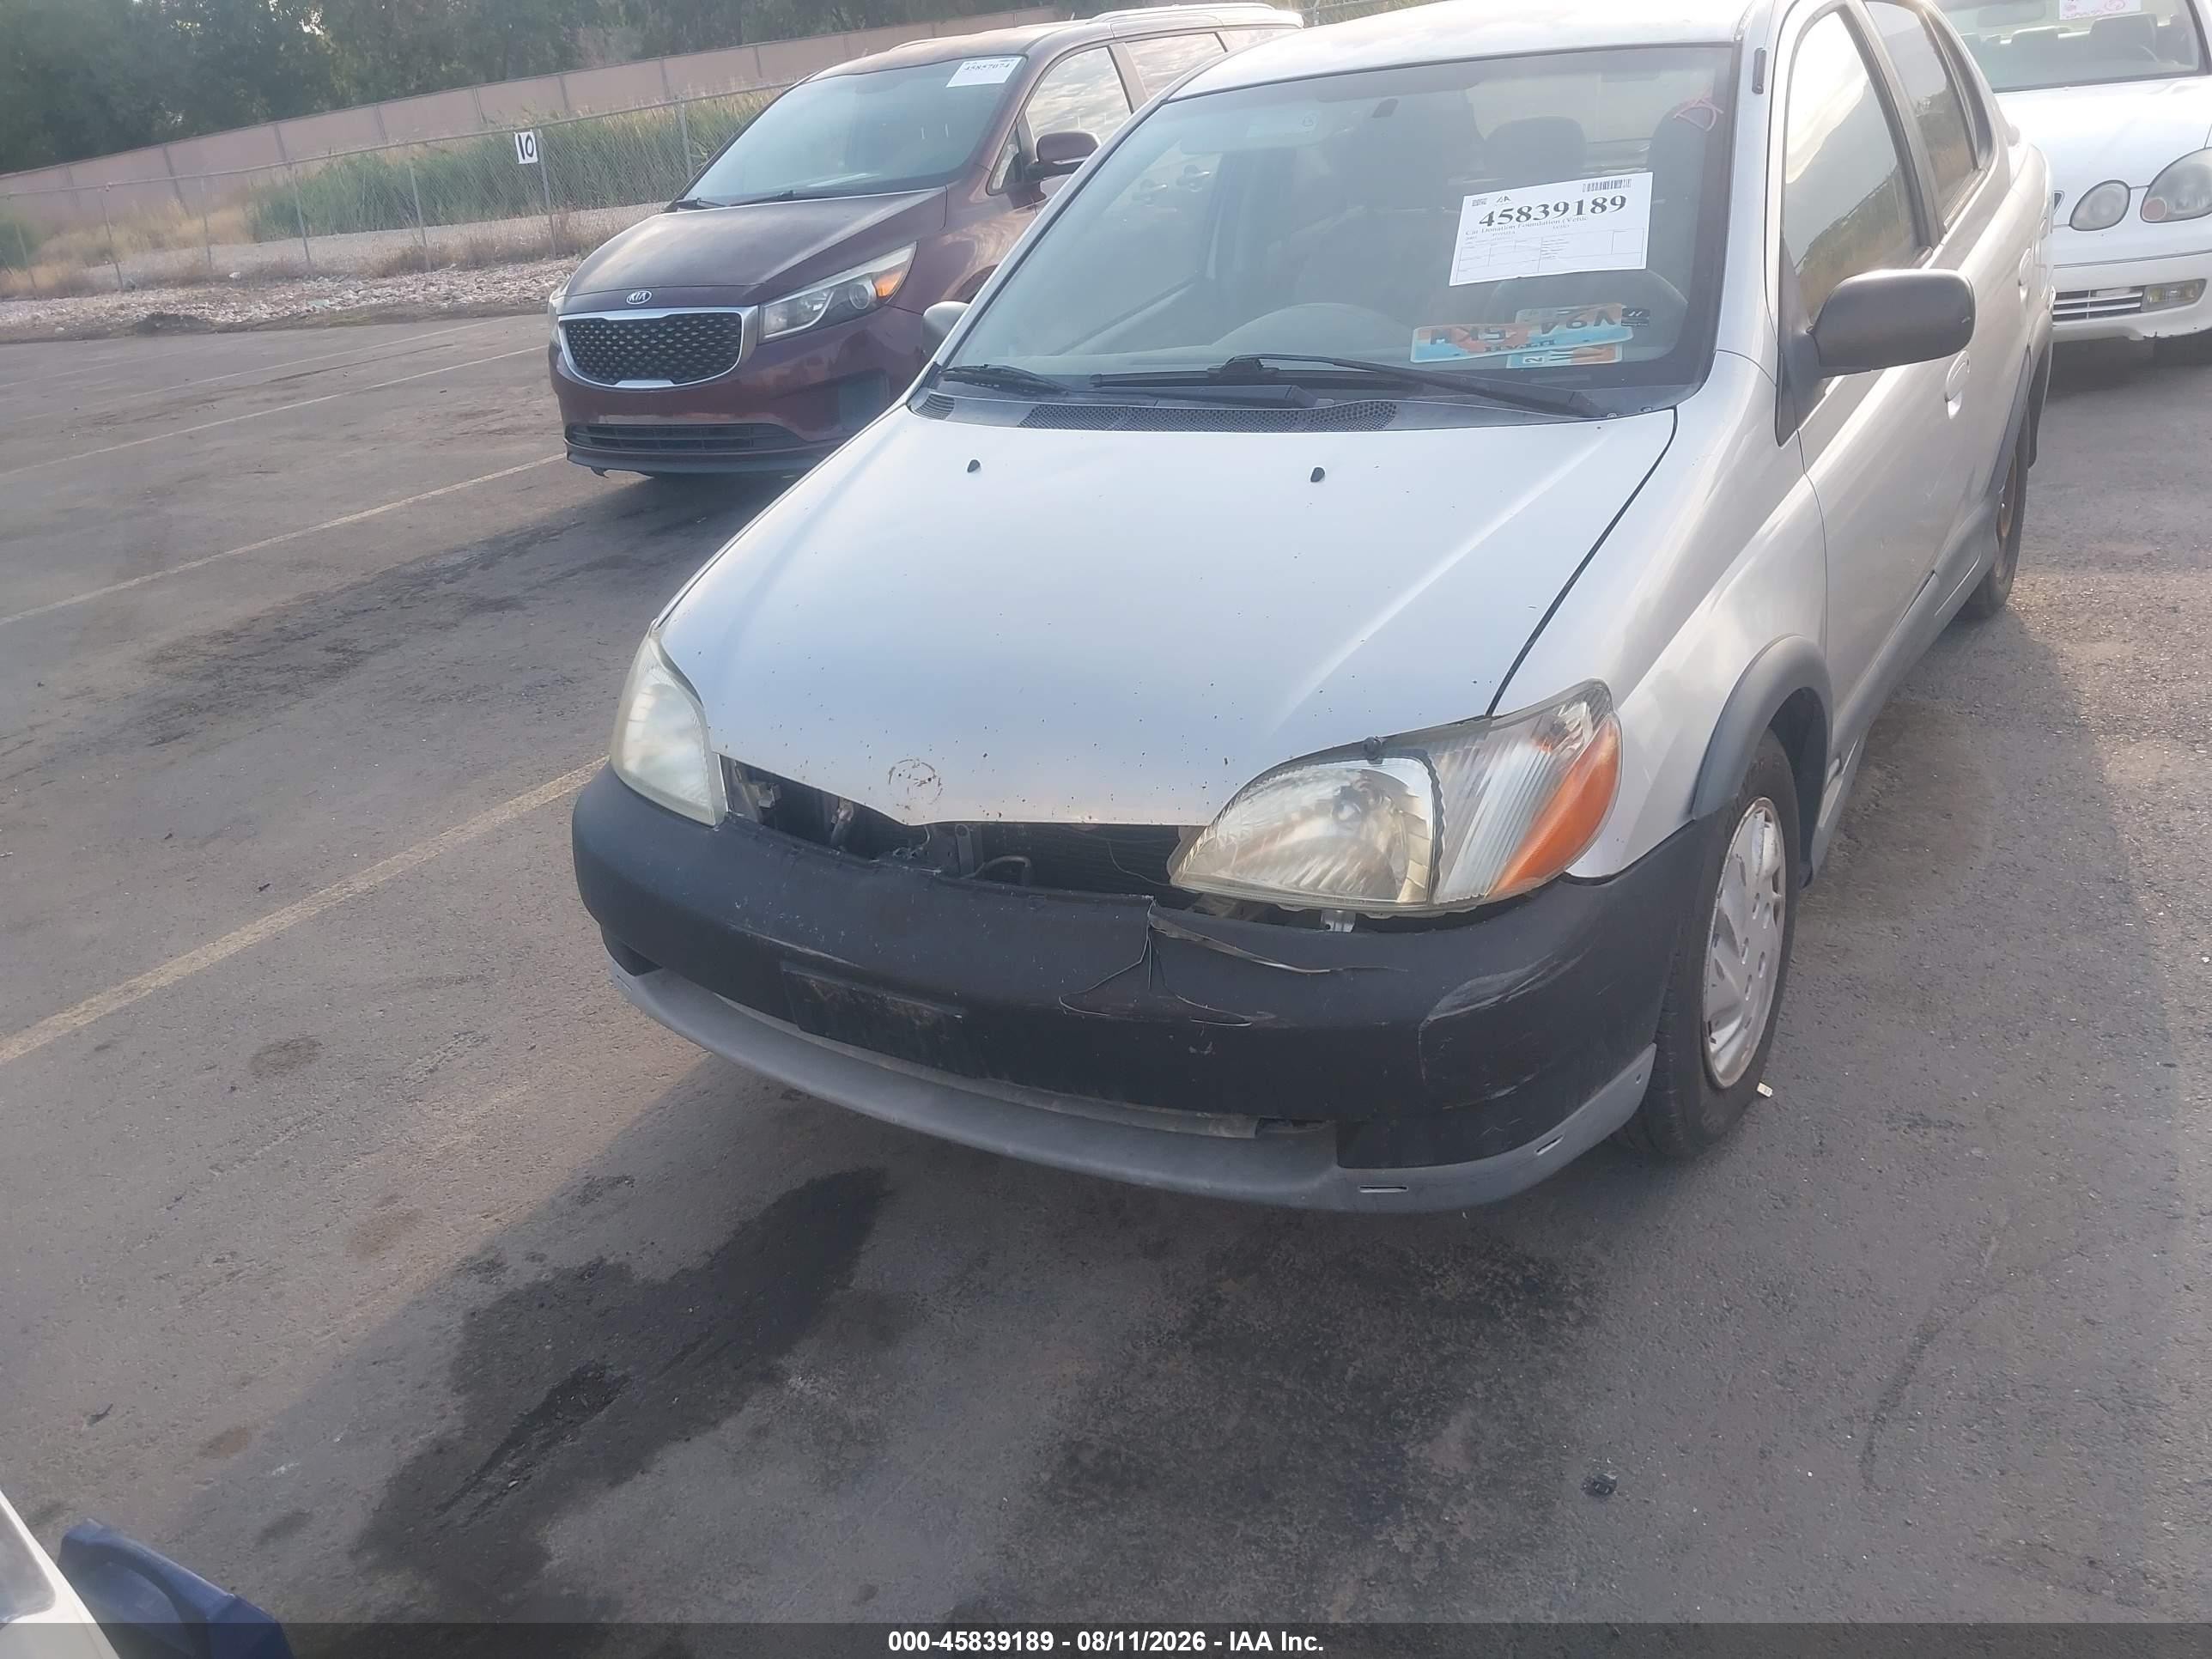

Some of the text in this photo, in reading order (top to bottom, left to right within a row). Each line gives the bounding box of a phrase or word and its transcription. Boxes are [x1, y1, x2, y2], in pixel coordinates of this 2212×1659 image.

[518, 134, 534, 160] 10
[1479, 195, 1626, 227] 45839189
[629, 292, 647, 301] KIA
